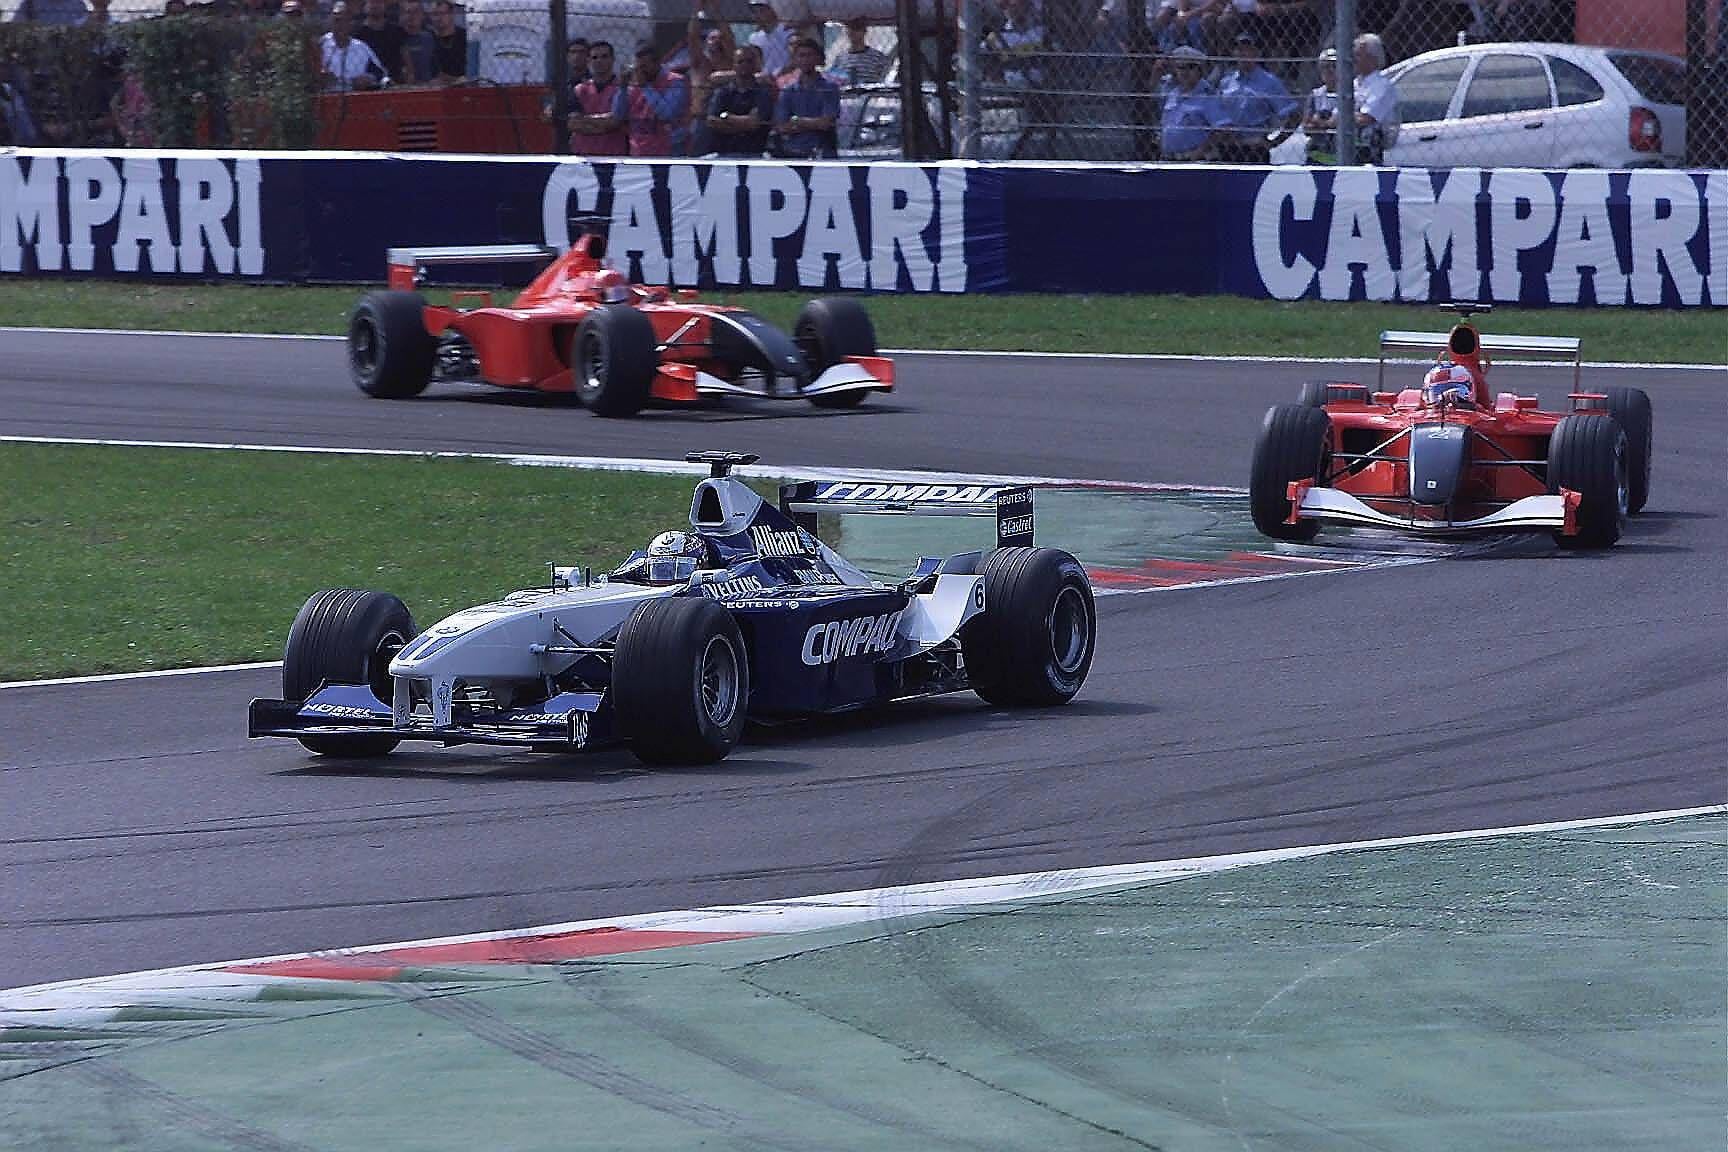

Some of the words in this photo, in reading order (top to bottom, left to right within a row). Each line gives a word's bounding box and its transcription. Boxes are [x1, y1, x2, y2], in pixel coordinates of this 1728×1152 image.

[543, 163, 968, 292] CAMPARI
[1252, 168, 1728, 305] CAMPARI
[751, 525, 805, 558] Allianz
[1007, 516, 1033, 534] Castrol
[706, 575, 762, 600] VELTINS
[975, 584, 984, 609] 6
[802, 610, 903, 666] COMPAQ
